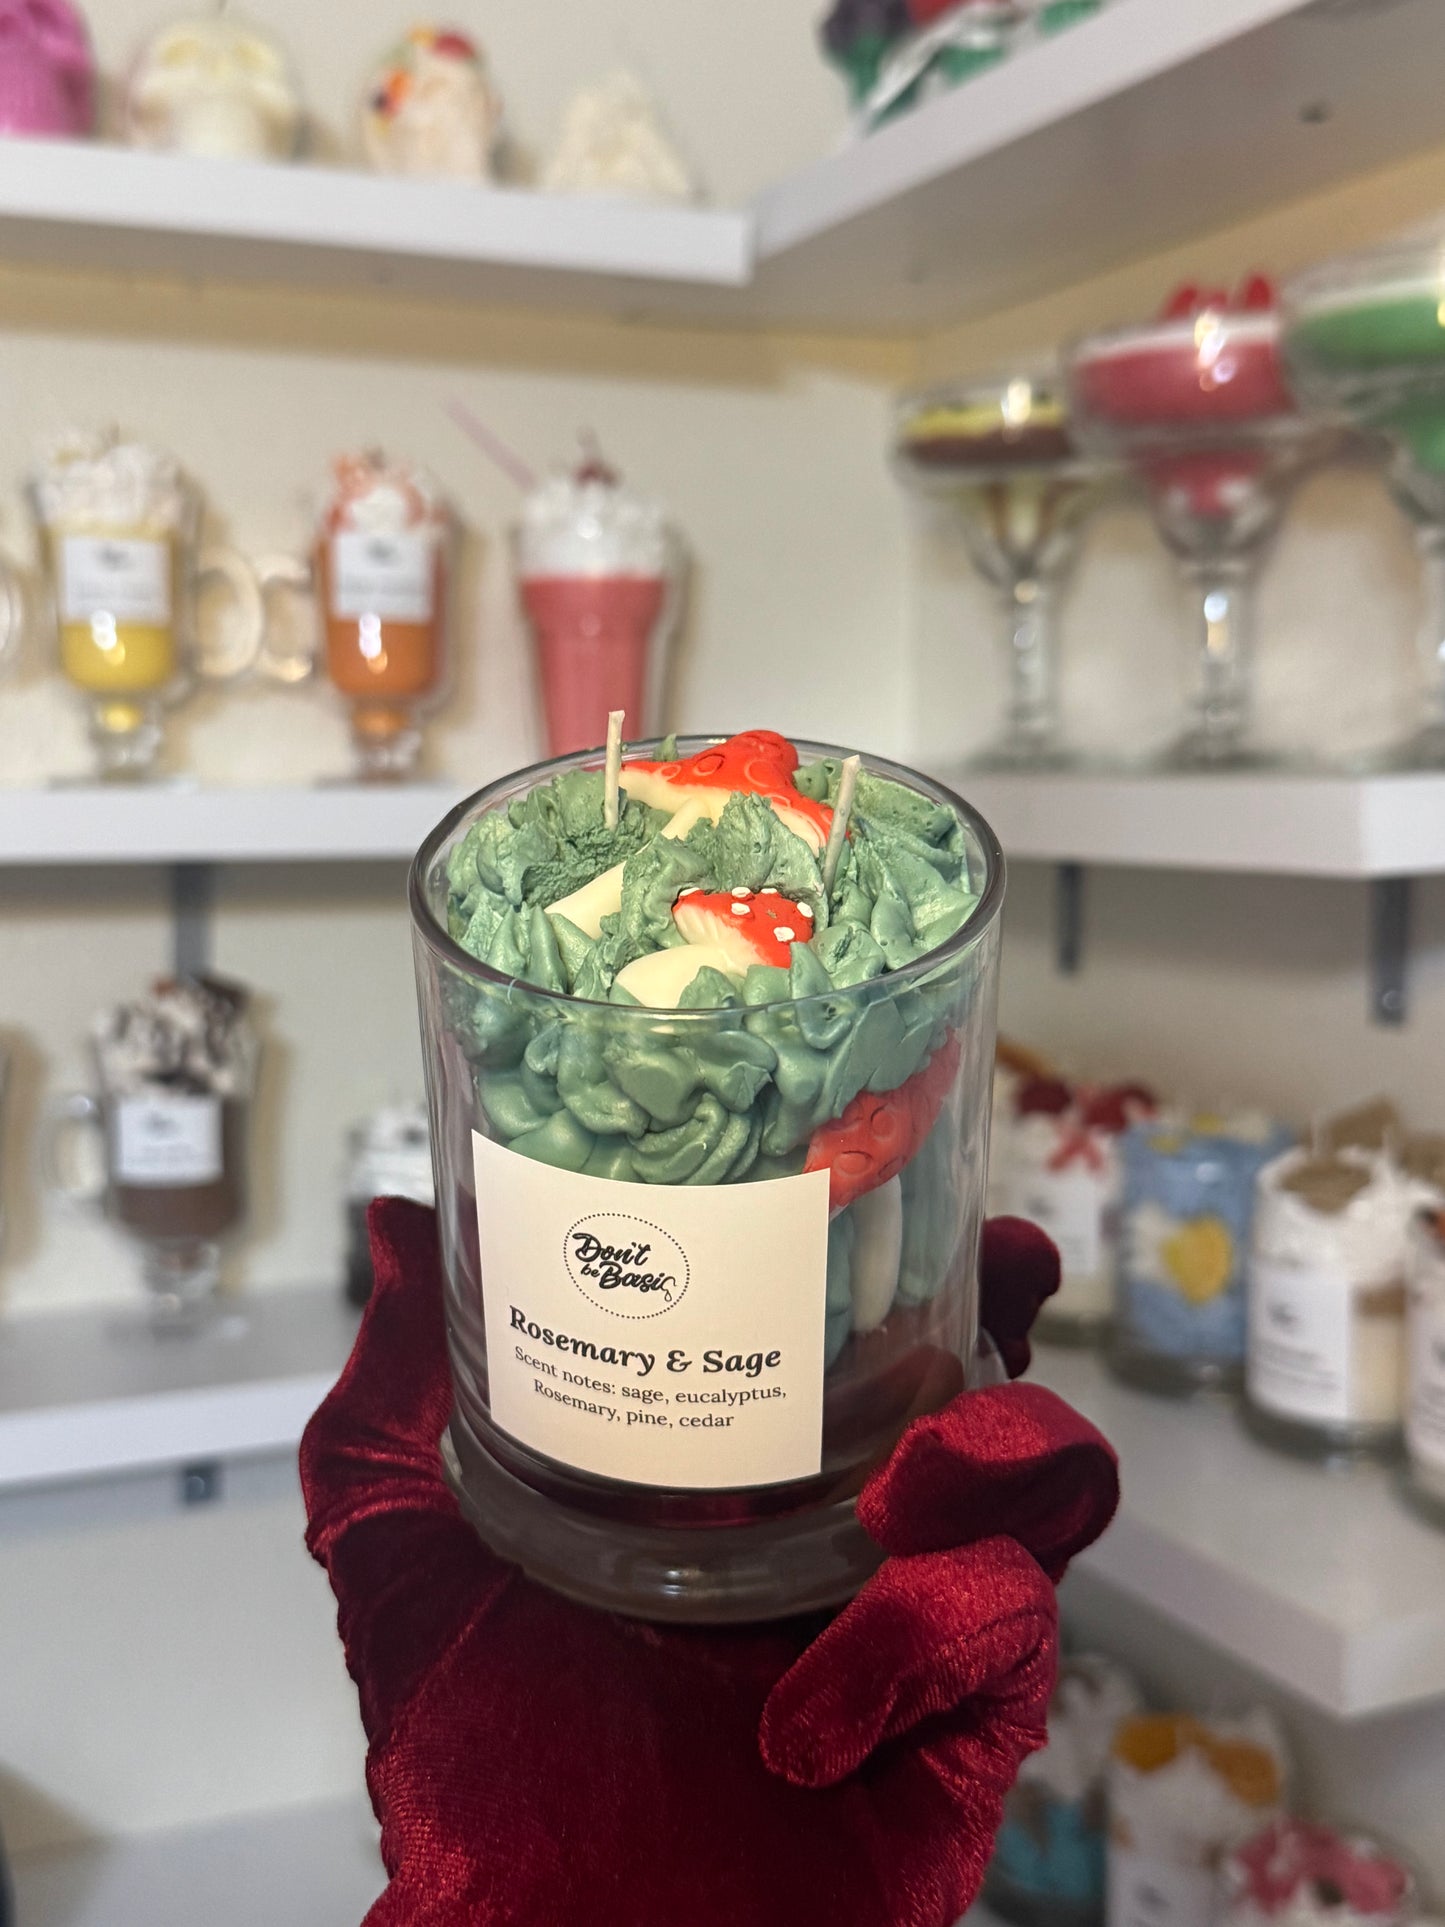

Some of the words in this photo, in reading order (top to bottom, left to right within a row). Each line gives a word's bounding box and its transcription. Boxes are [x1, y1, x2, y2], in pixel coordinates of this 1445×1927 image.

[572, 1232, 652, 1266] Don't
[580, 1263, 601, 1278] be
[598, 1260, 677, 1303] Basic
[509, 1305, 655, 1377] Rosemary
[666, 1350, 693, 1373] &
[702, 1348, 782, 1378] Sage
[515, 1346, 558, 1377] Scent
[562, 1370, 616, 1395] notes:
[621, 1386, 670, 1404] sage,
[675, 1384, 787, 1407] eucalyptus,
[533, 1378, 622, 1422] Rosemary,
[625, 1409, 673, 1428] pine,
[678, 1414, 735, 1428] cedar
